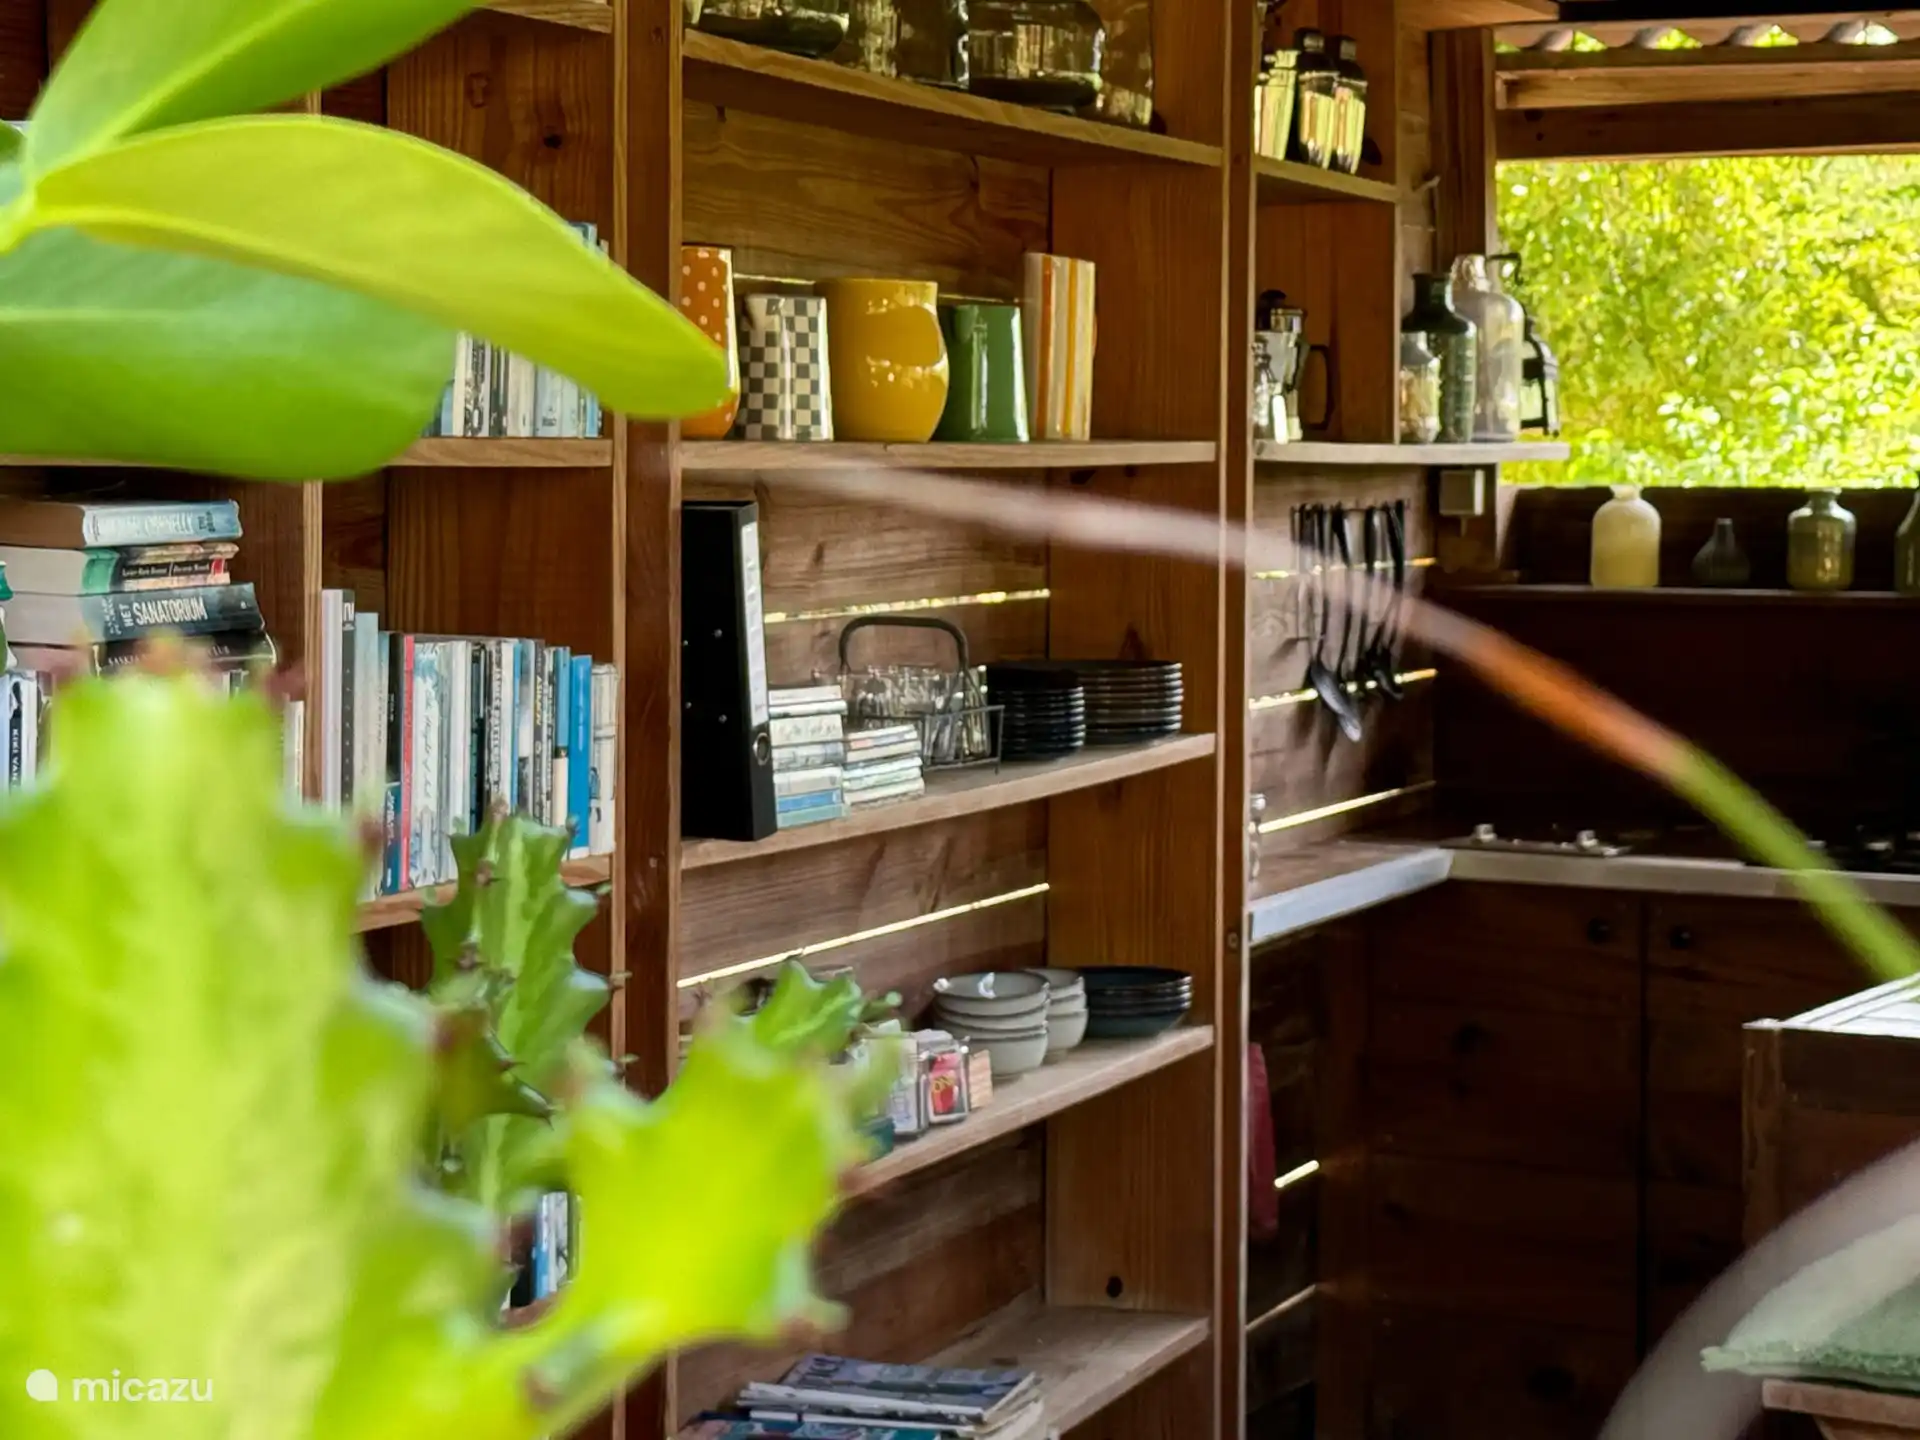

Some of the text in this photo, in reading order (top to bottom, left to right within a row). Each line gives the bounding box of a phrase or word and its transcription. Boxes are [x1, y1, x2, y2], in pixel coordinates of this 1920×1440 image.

[119, 602, 135, 628] HET
[132, 596, 208, 627] SANATORIUM
[11, 728, 19, 782] KIKI VAN
